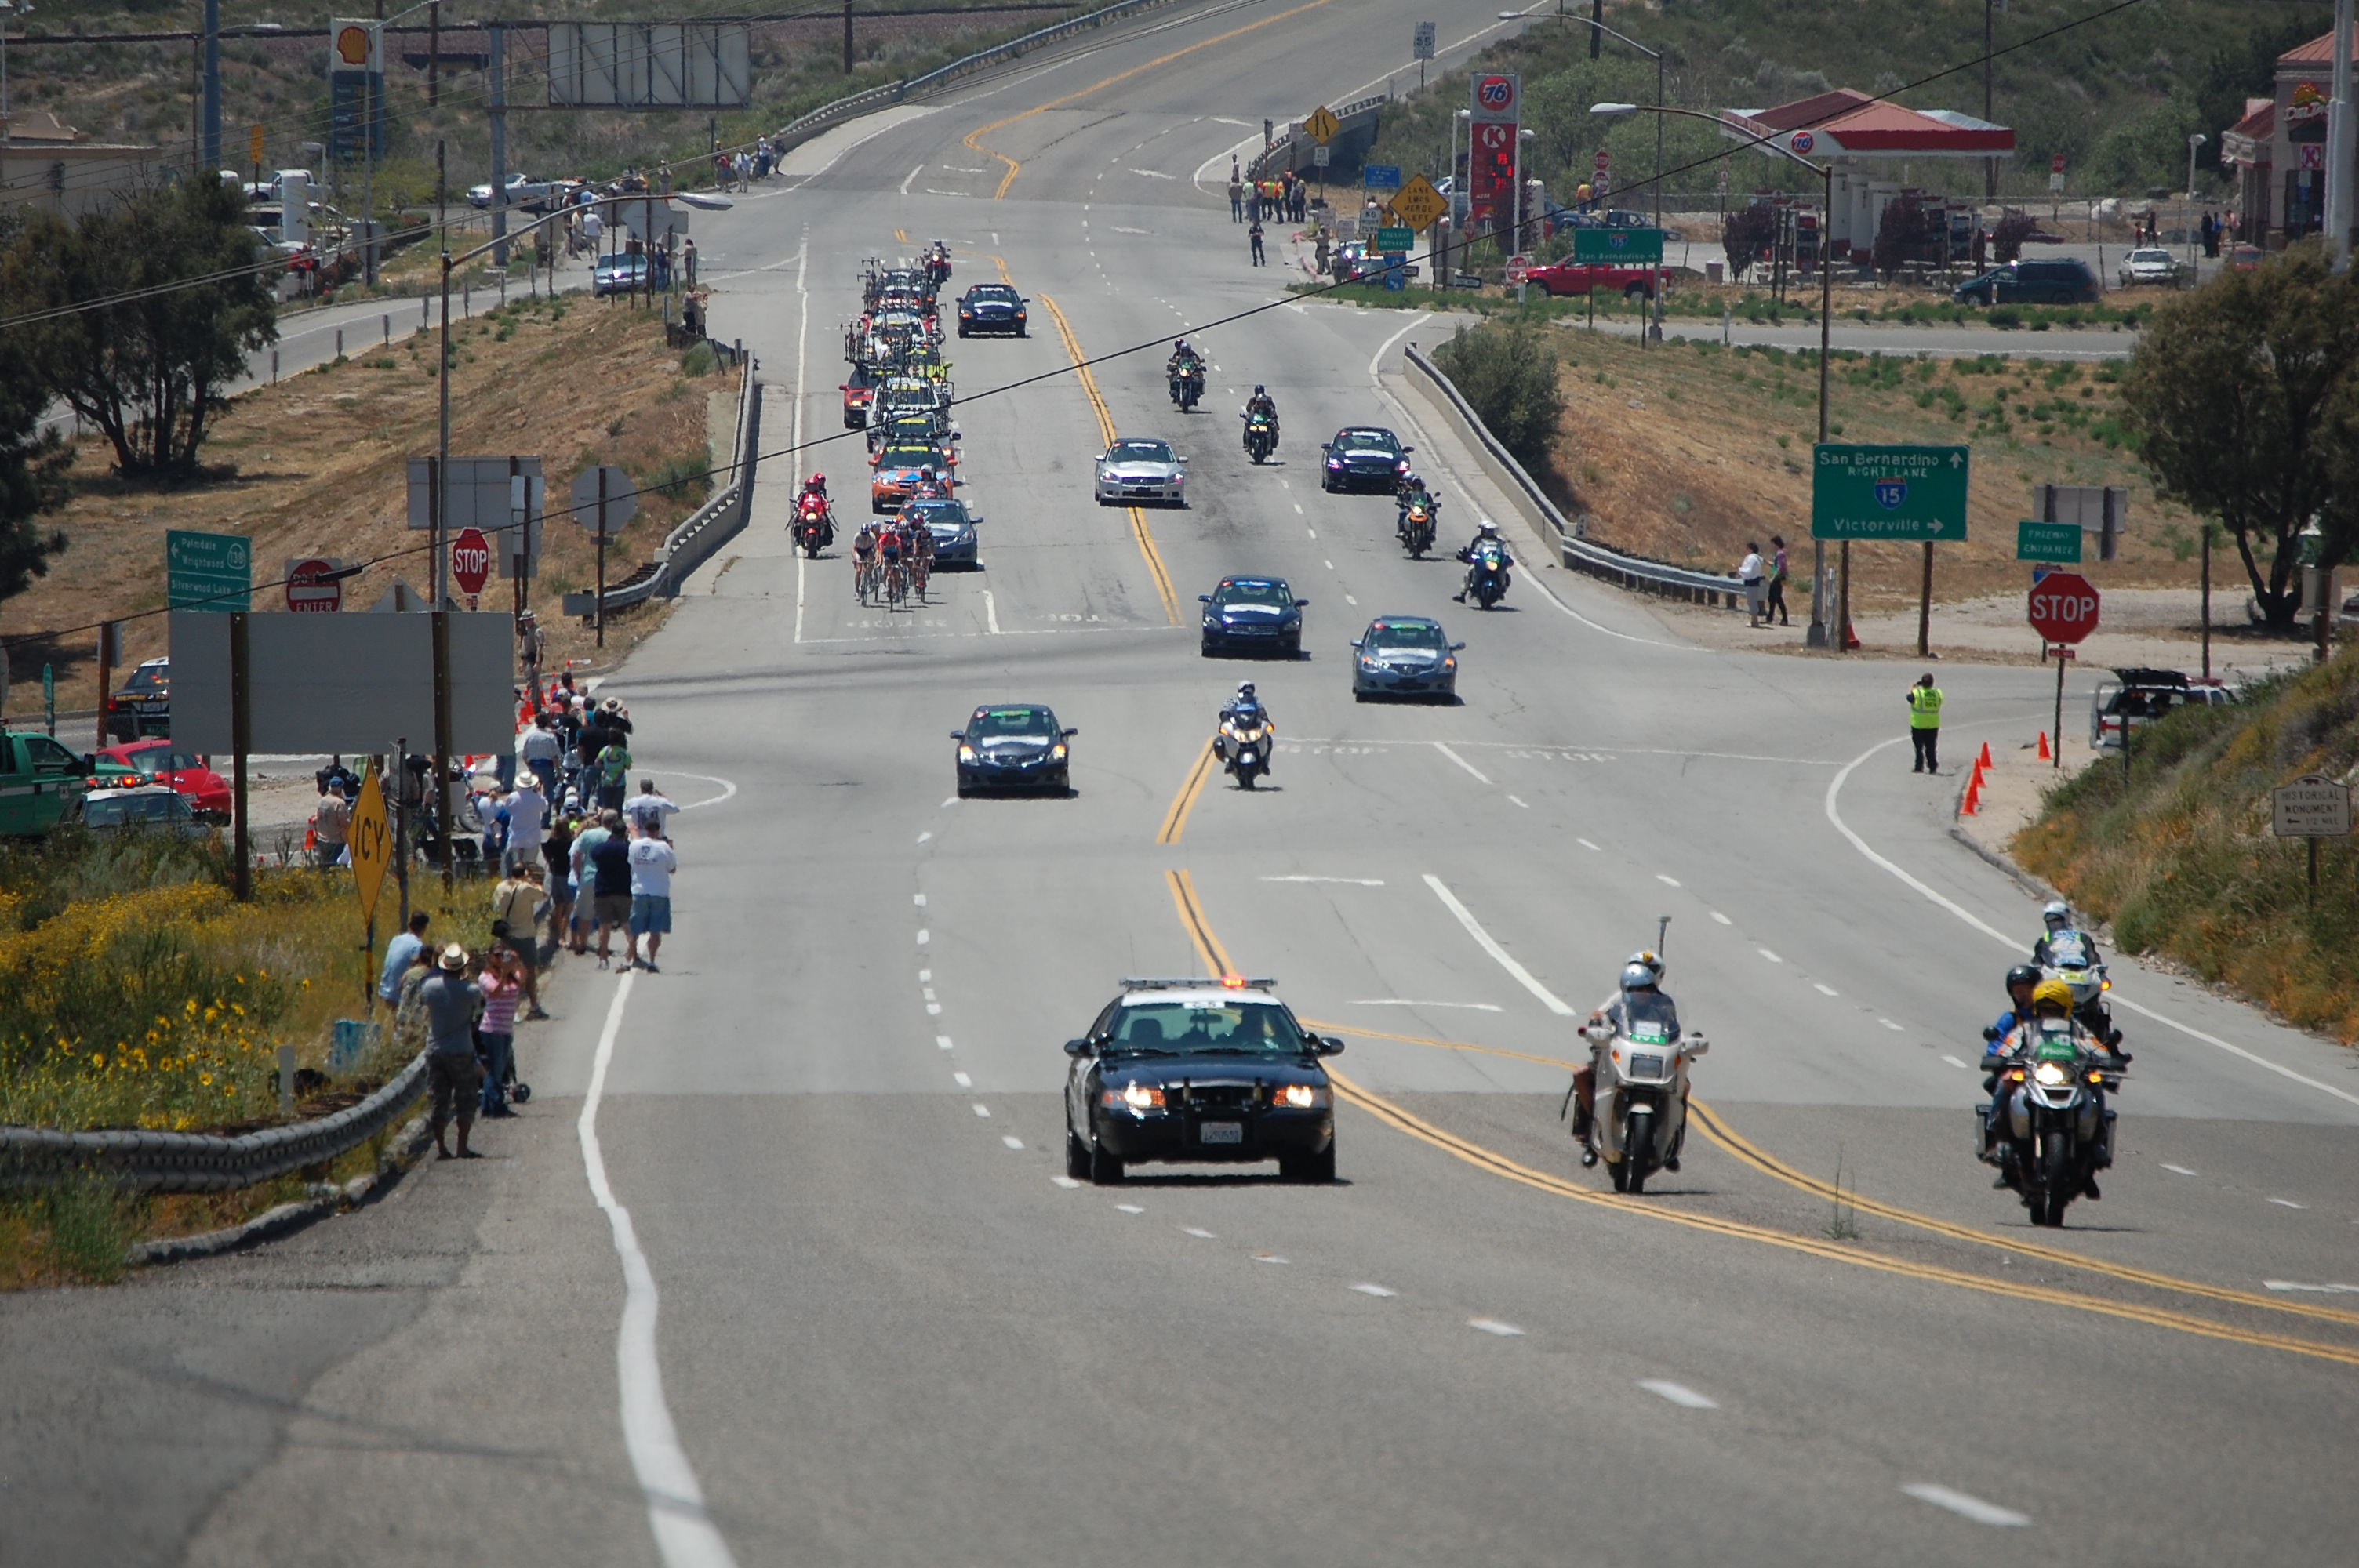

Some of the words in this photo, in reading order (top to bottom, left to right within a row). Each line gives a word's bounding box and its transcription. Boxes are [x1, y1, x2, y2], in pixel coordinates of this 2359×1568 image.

[1483, 82, 1507, 103] 76
[1794, 136, 1811, 150] 76
[1616, 238, 1624, 247] 15
[1599, 252, 1645, 260] Bernardino
[1819, 452, 1848, 466] San
[1855, 452, 1939, 466] Bernardino
[1848, 467, 1886, 477] RIGHT
[1895, 468, 1928, 478] LANE
[1882, 488, 1900, 504] 15
[1834, 518, 1920, 532] Victorville
[2028, 529, 2070, 540] FREEWAY
[182, 537, 216, 551] Palmdale
[2023, 543, 2074, 556] ENTRANCE
[182, 555, 225, 569] Wrightwood
[231, 551, 244, 564] 138
[455, 548, 488, 575] STOP
[172, 579, 211, 593] Silverwood
[213, 583, 231, 595] Lake
[296, 601, 333, 612] ENTER
[2032, 594, 2095, 622] STOP
[2282, 789, 2341, 800] HISTORICAL
[2285, 804, 2338, 814] MONUMENT
[354, 815, 384, 863] ICY
